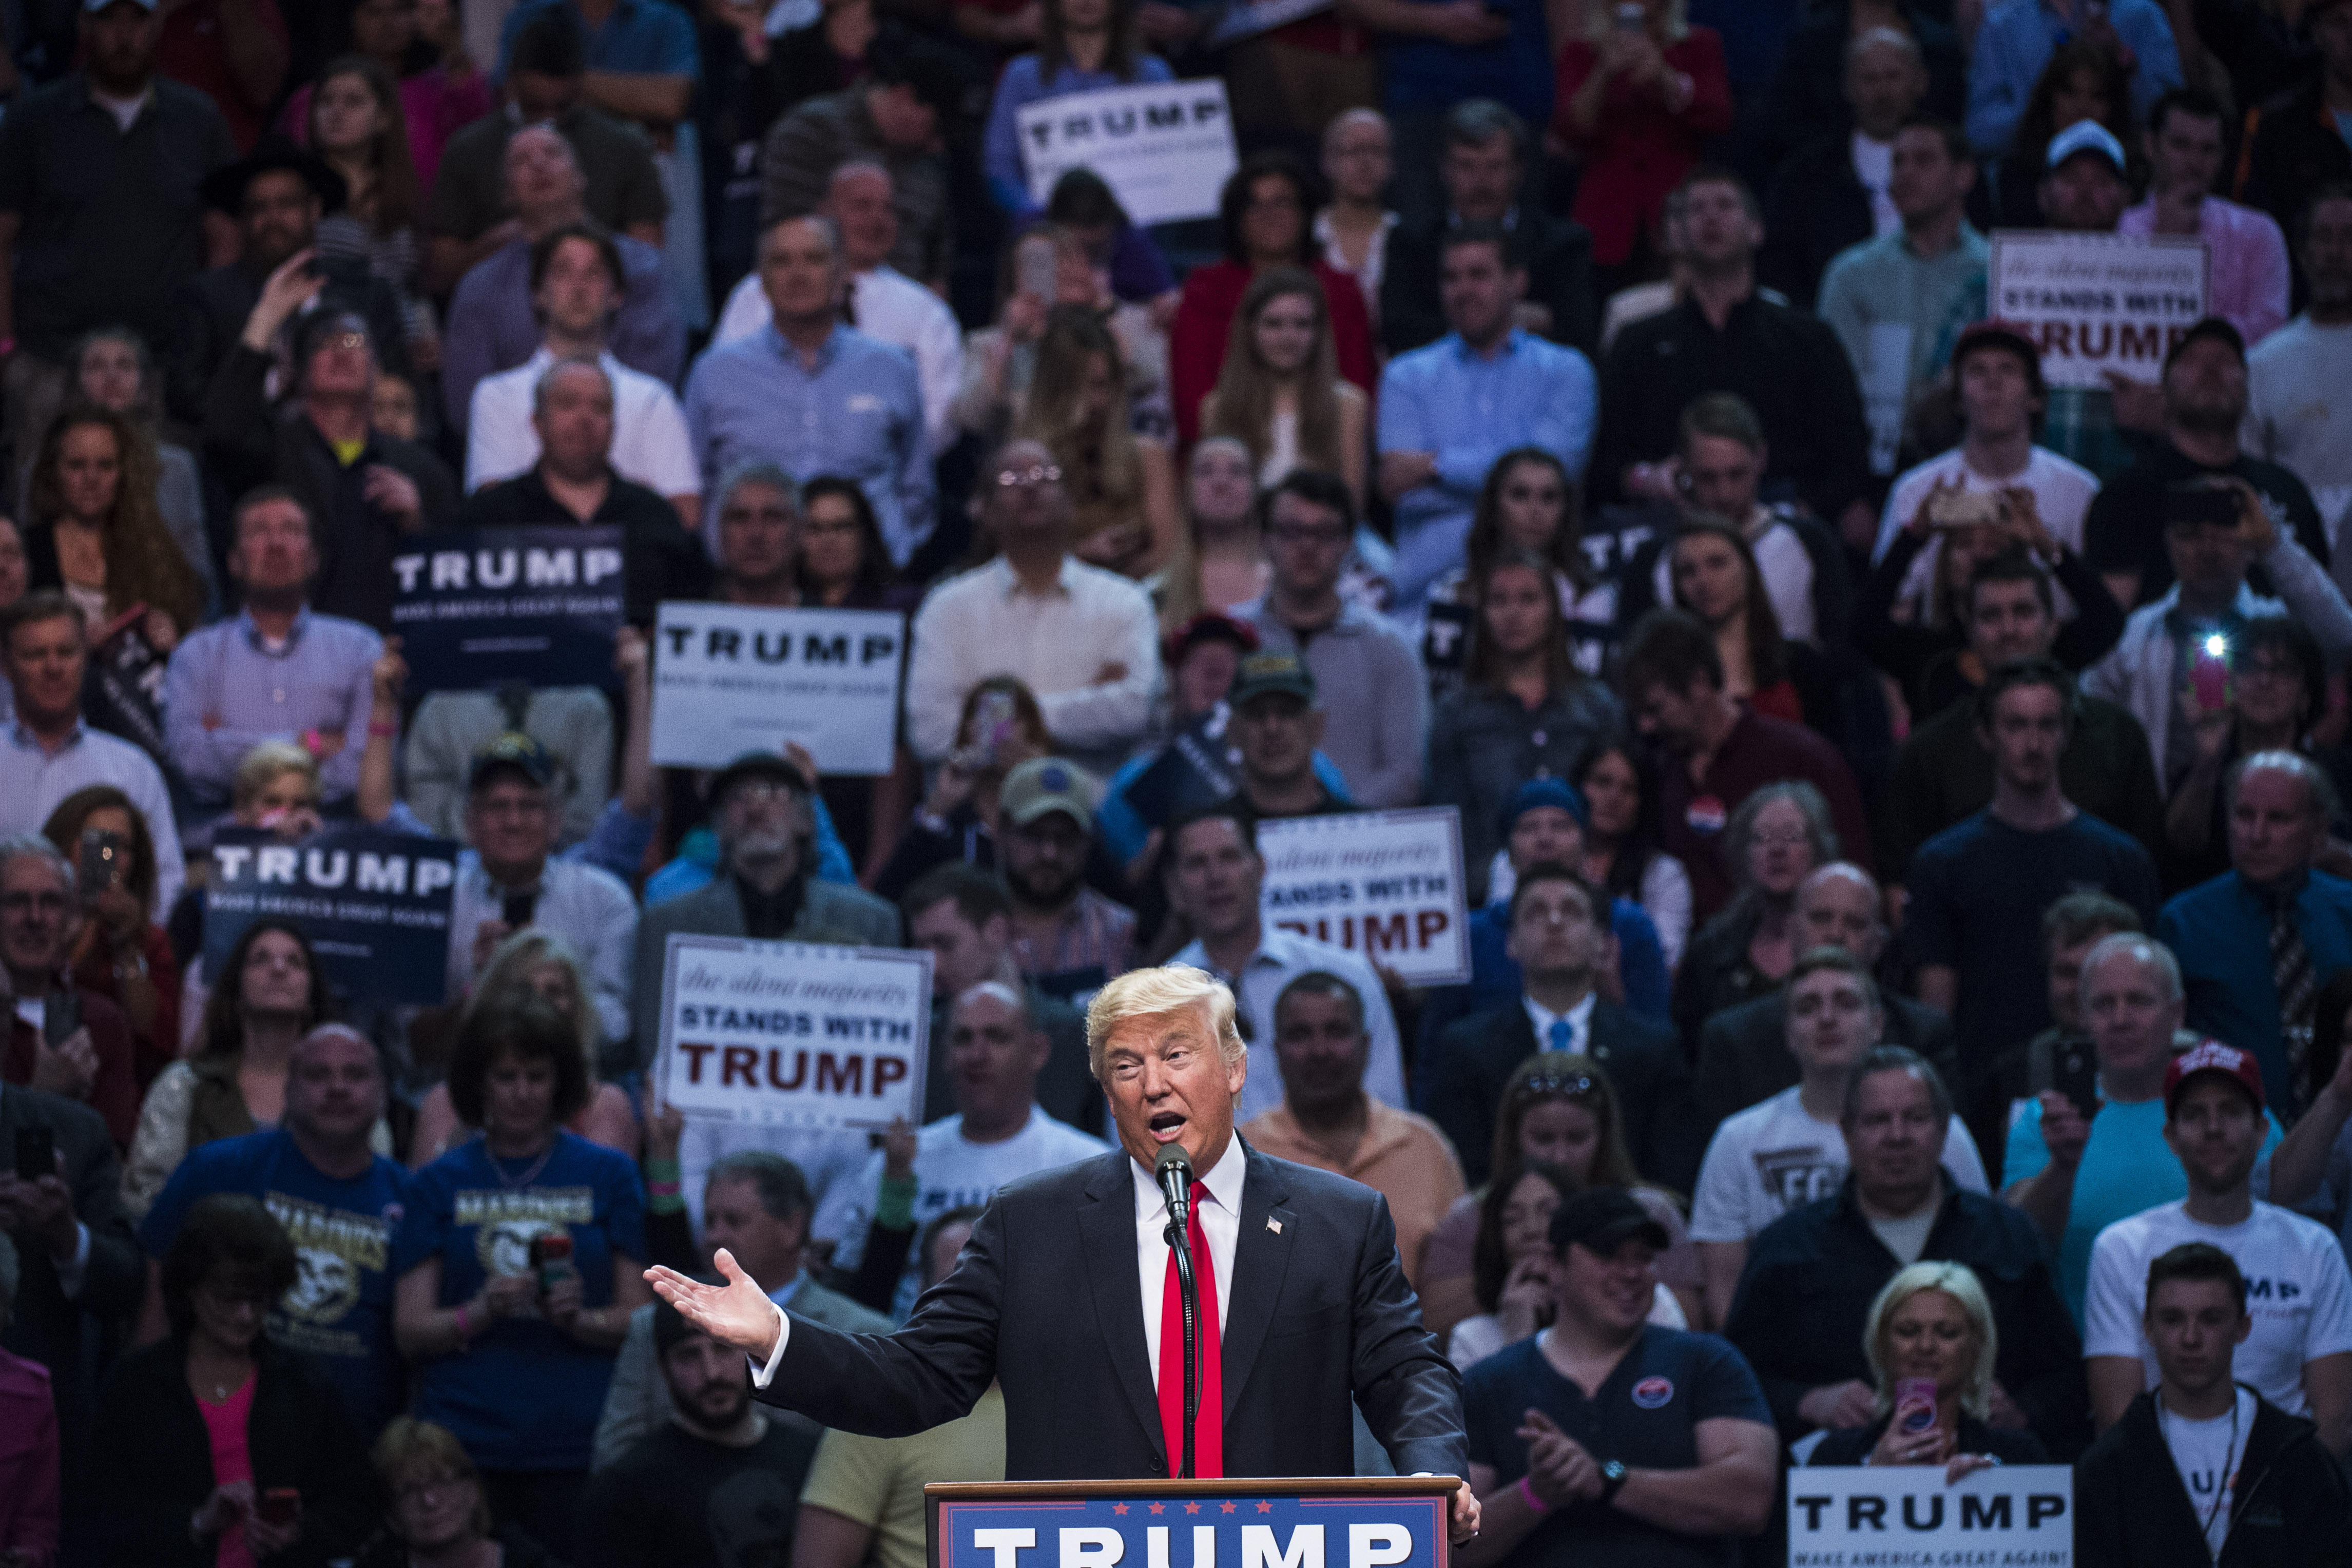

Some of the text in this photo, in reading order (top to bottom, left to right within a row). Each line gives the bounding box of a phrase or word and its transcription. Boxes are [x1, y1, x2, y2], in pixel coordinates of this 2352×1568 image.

[1031, 101, 1221, 148] TRUMP
[2004, 288, 2197, 314] STANDS WITH
[393, 548, 623, 592] TRUMP
[666, 626, 894, 665] TRUMP
[213, 845, 454, 897] TRUMP
[1364, 874, 1448, 900] WITH
[681, 1005, 913, 1042] STANDS WITH
[678, 1042, 909, 1097] TRUMP
[1795, 1494, 2066, 1532] TRUMP
[973, 1523, 1413, 1568] TRUMP
[1795, 1551, 1844, 1566] MAKE
[1850, 1551, 1934, 1566] AMERICA
[1939, 1551, 1998, 1566] GREAT
